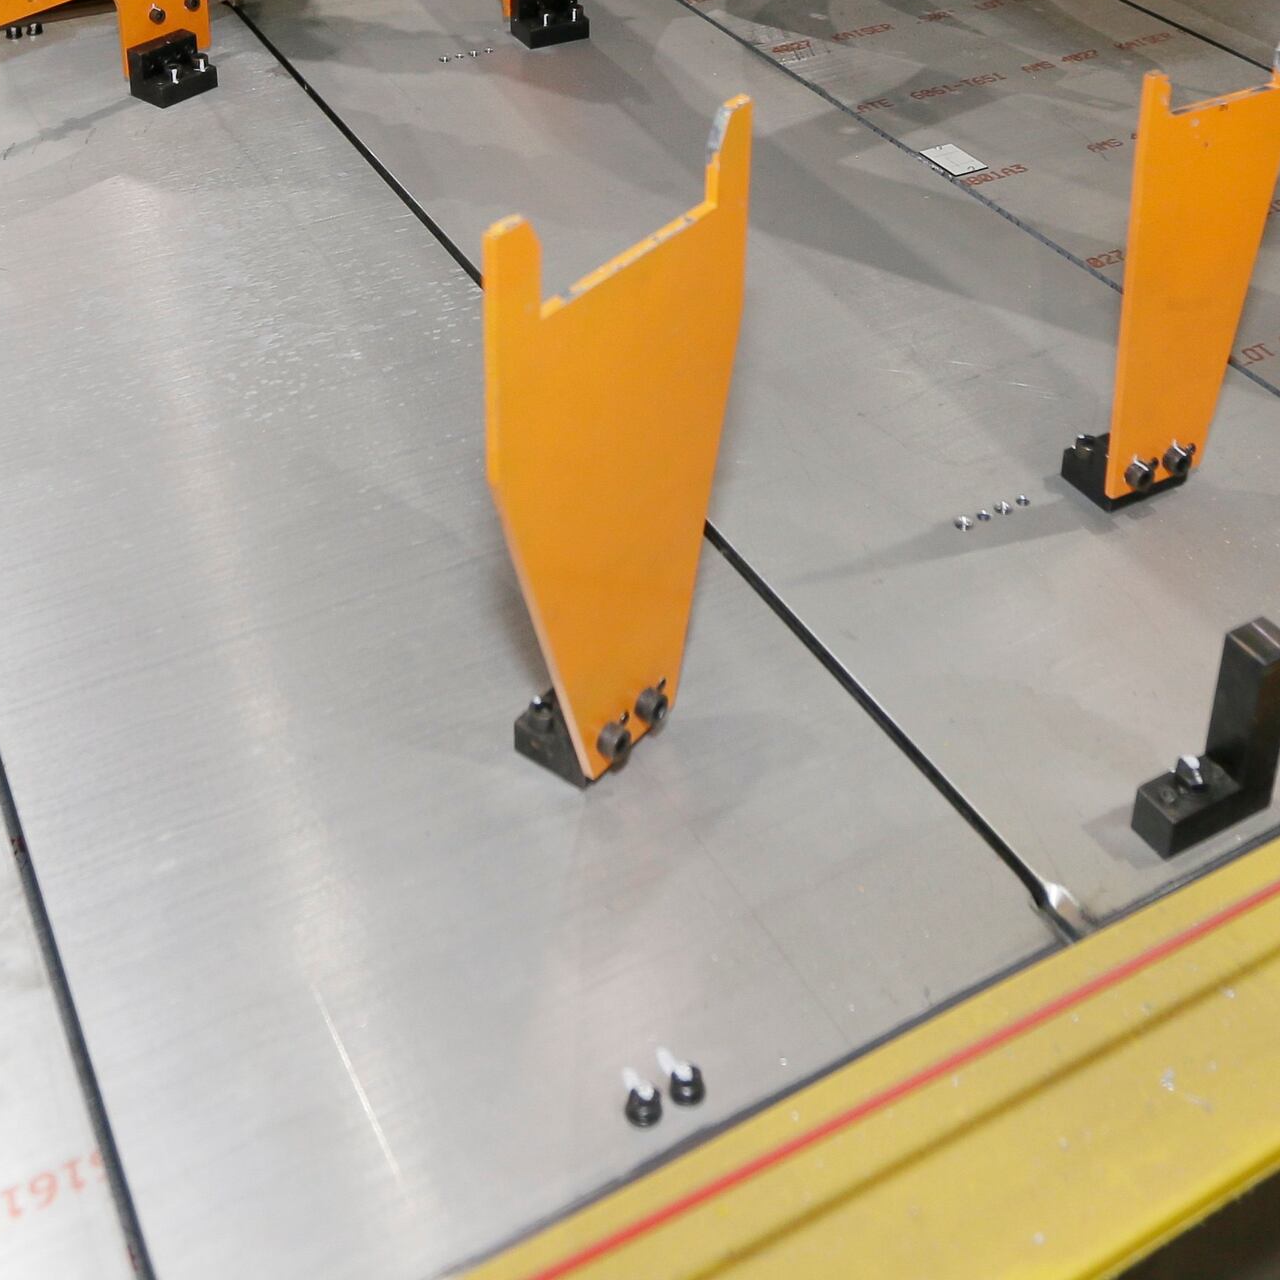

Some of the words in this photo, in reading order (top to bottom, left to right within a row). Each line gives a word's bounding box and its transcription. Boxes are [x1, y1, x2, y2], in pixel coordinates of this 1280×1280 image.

[770, 39, 813, 57] 4027
[831, 22, 895, 43] KAISER
[909, 71, 1008, 101] 6061-T651
[1020, 60, 1057, 75] AMS
[1061, 48, 1100, 65] 4027
[1086, 137, 1124, 154] AMS
